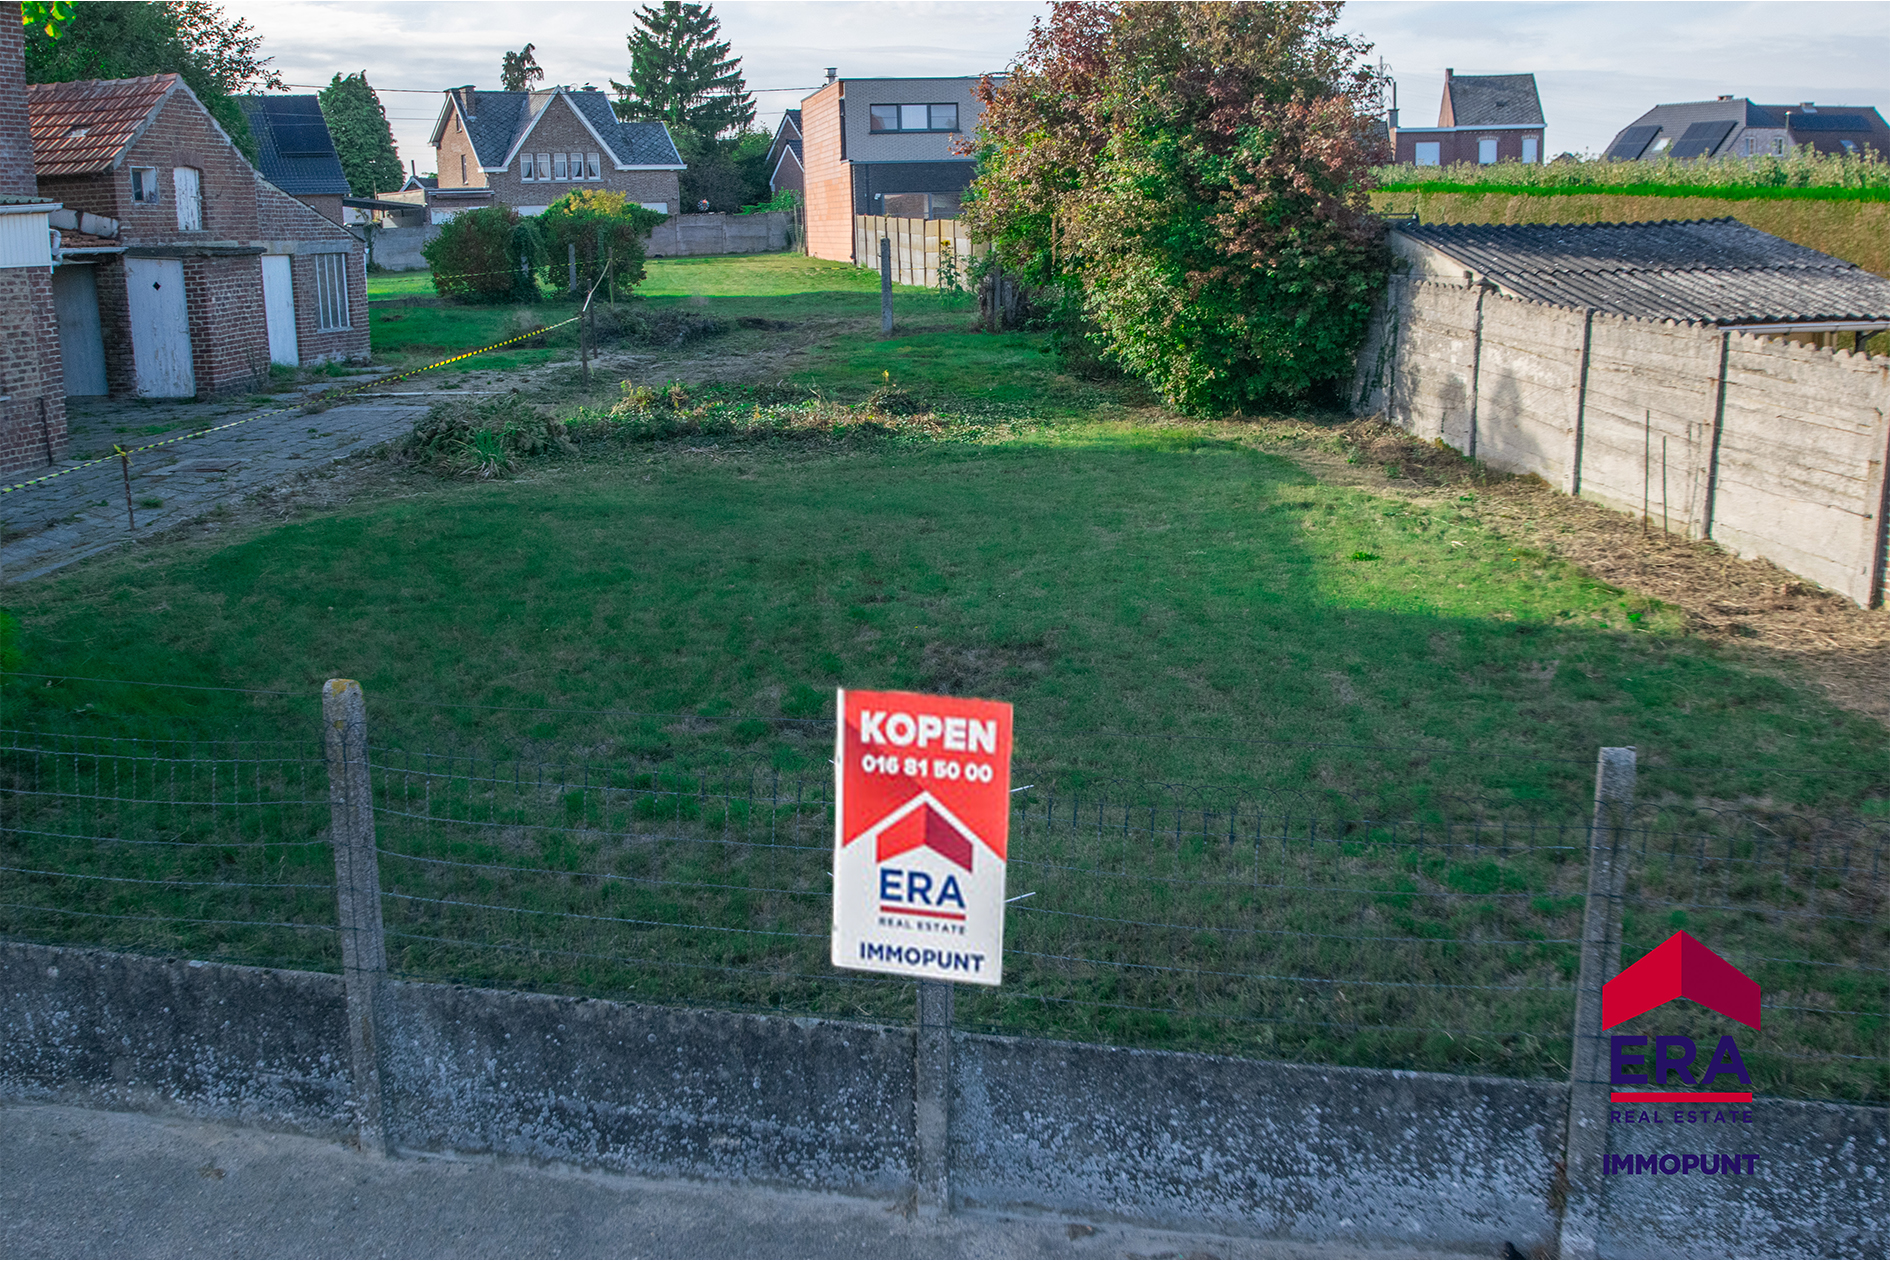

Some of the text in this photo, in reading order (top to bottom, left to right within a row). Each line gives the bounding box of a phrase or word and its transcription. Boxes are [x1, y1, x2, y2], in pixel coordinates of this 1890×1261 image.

[860, 709, 997, 755] KOPEN
[861, 754, 993, 783] 016 81 50 00
[879, 866, 966, 909] ERA
[879, 917, 966, 935] REAL ESTATE
[860, 941, 985, 972] IMMOPUNT
